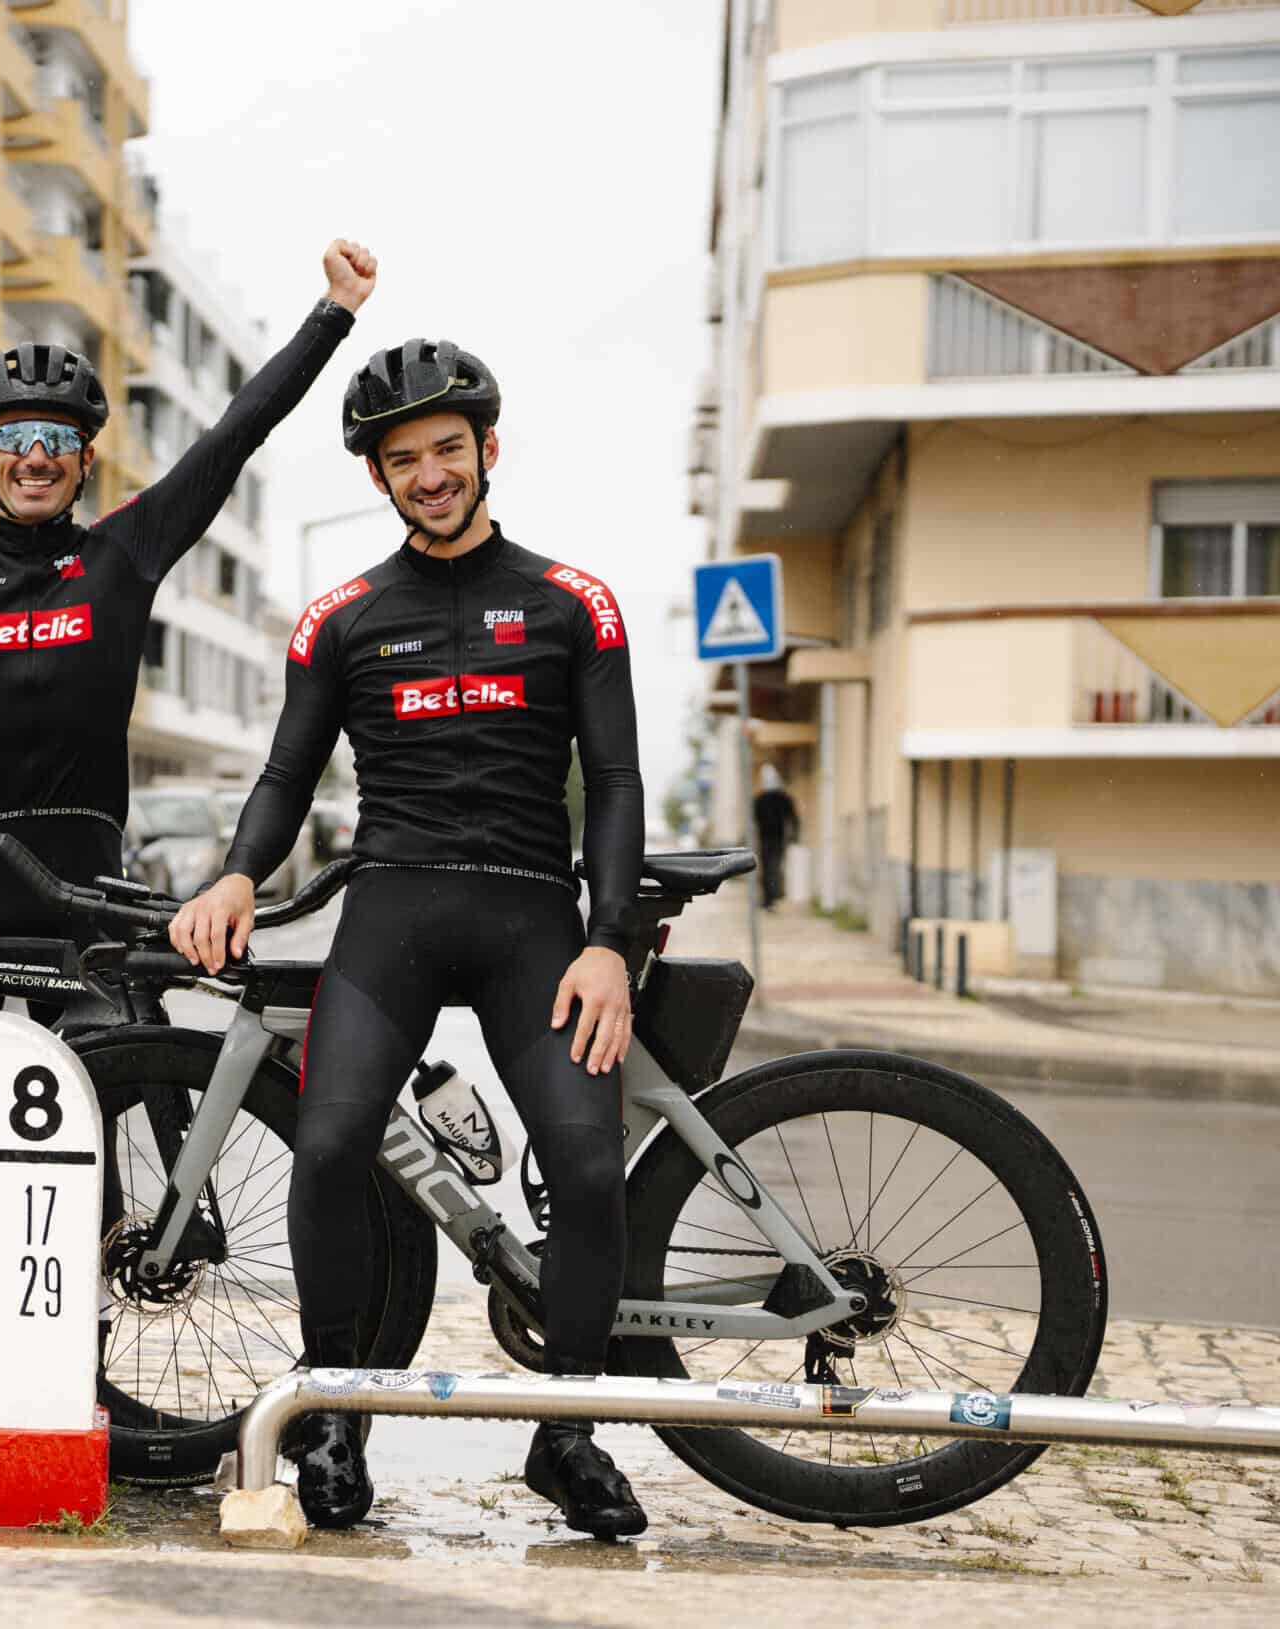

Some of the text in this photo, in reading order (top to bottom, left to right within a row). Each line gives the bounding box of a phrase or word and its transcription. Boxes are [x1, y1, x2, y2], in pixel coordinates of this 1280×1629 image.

[292, 582, 362, 657] Betclic
[483, 610, 524, 623] DESAFIA
[553, 567, 618, 640] Betclic
[400, 682, 517, 713] Betclic
[25, 1184, 57, 1246] 17
[19, 1256, 62, 1317] 29
